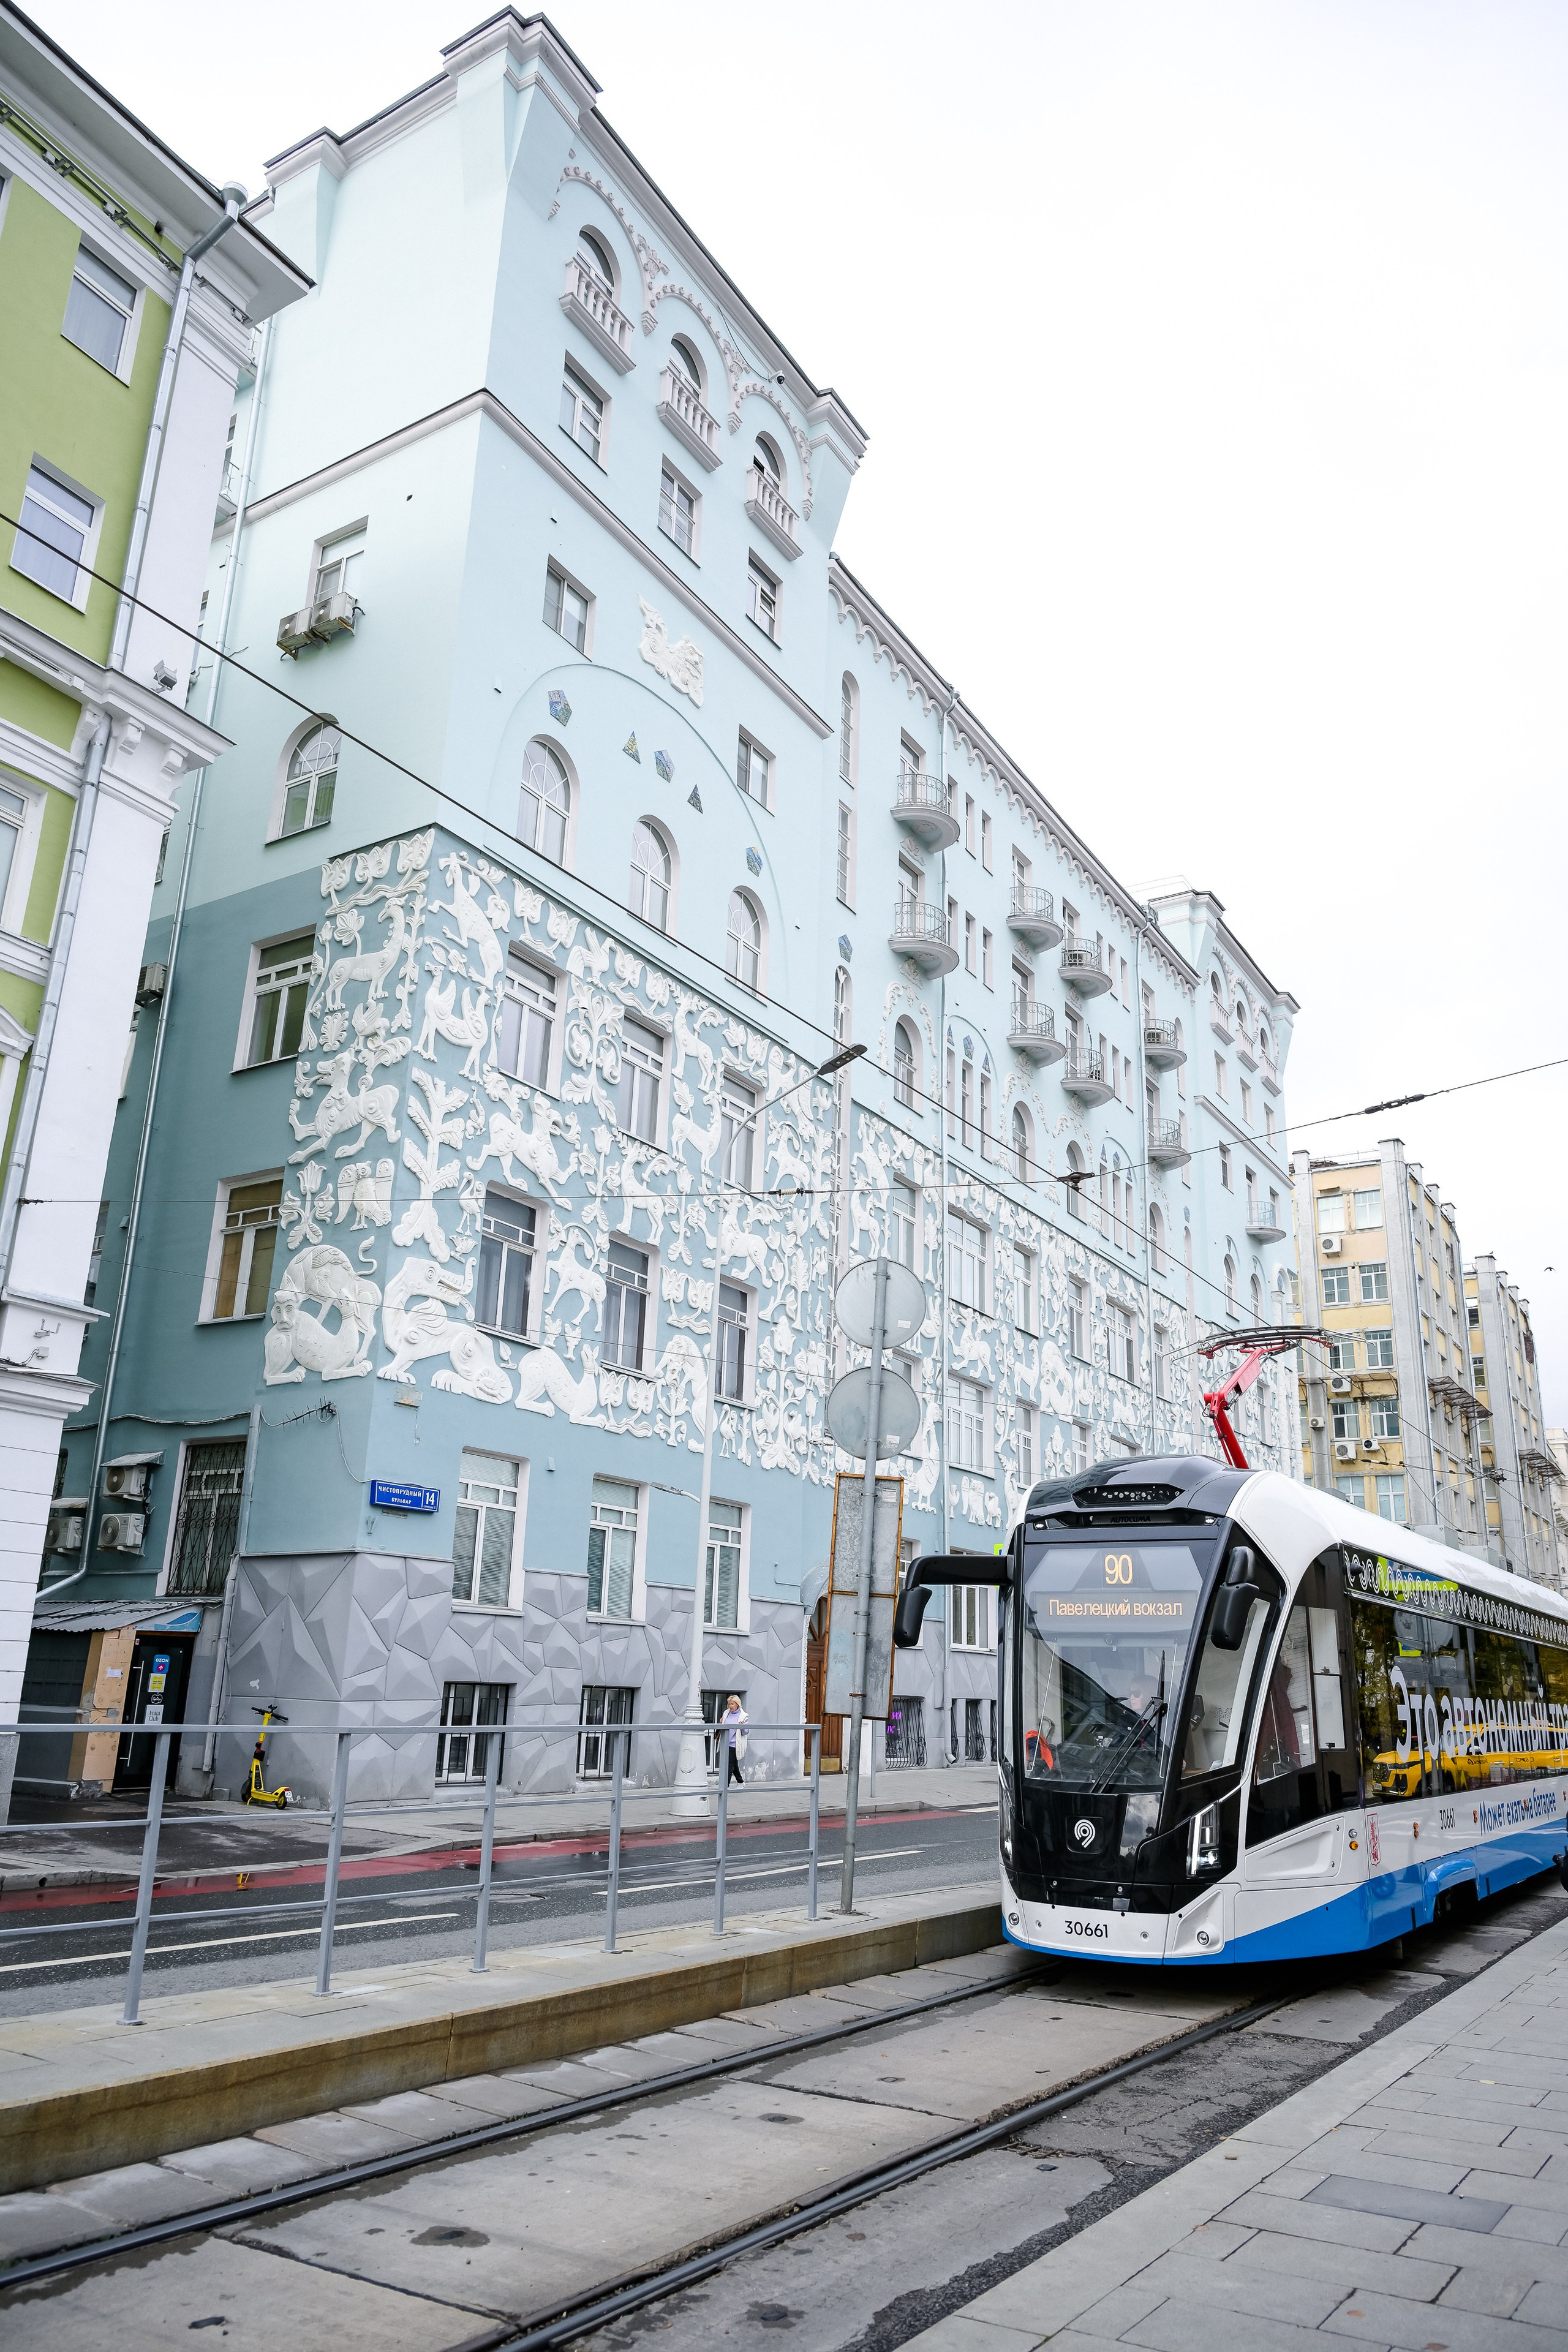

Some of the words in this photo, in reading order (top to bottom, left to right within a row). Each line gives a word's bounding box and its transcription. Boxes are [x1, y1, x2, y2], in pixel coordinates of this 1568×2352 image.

[379, 1486, 421, 1497] ЧИСТОПРУДНЫЙ
[426, 1492, 435, 1505] 14
[1104, 1554, 1133, 1584] 90
[1049, 1599, 1131, 1618] Павелецкий
[1133, 1602, 1183, 1616] вокзал
[1390, 1665, 1439, 1762] Это
[1441, 1683, 1551, 1758] автономный
[1439, 1807, 1455, 1830] 30661
[1479, 1801, 1505, 1836] Может
[1507, 1800, 1525, 1825] ехать
[1526, 1798, 1534, 1820] на
[1533, 1787, 1556, 1820] батарее
[1065, 1921, 1109, 1939] 30661
